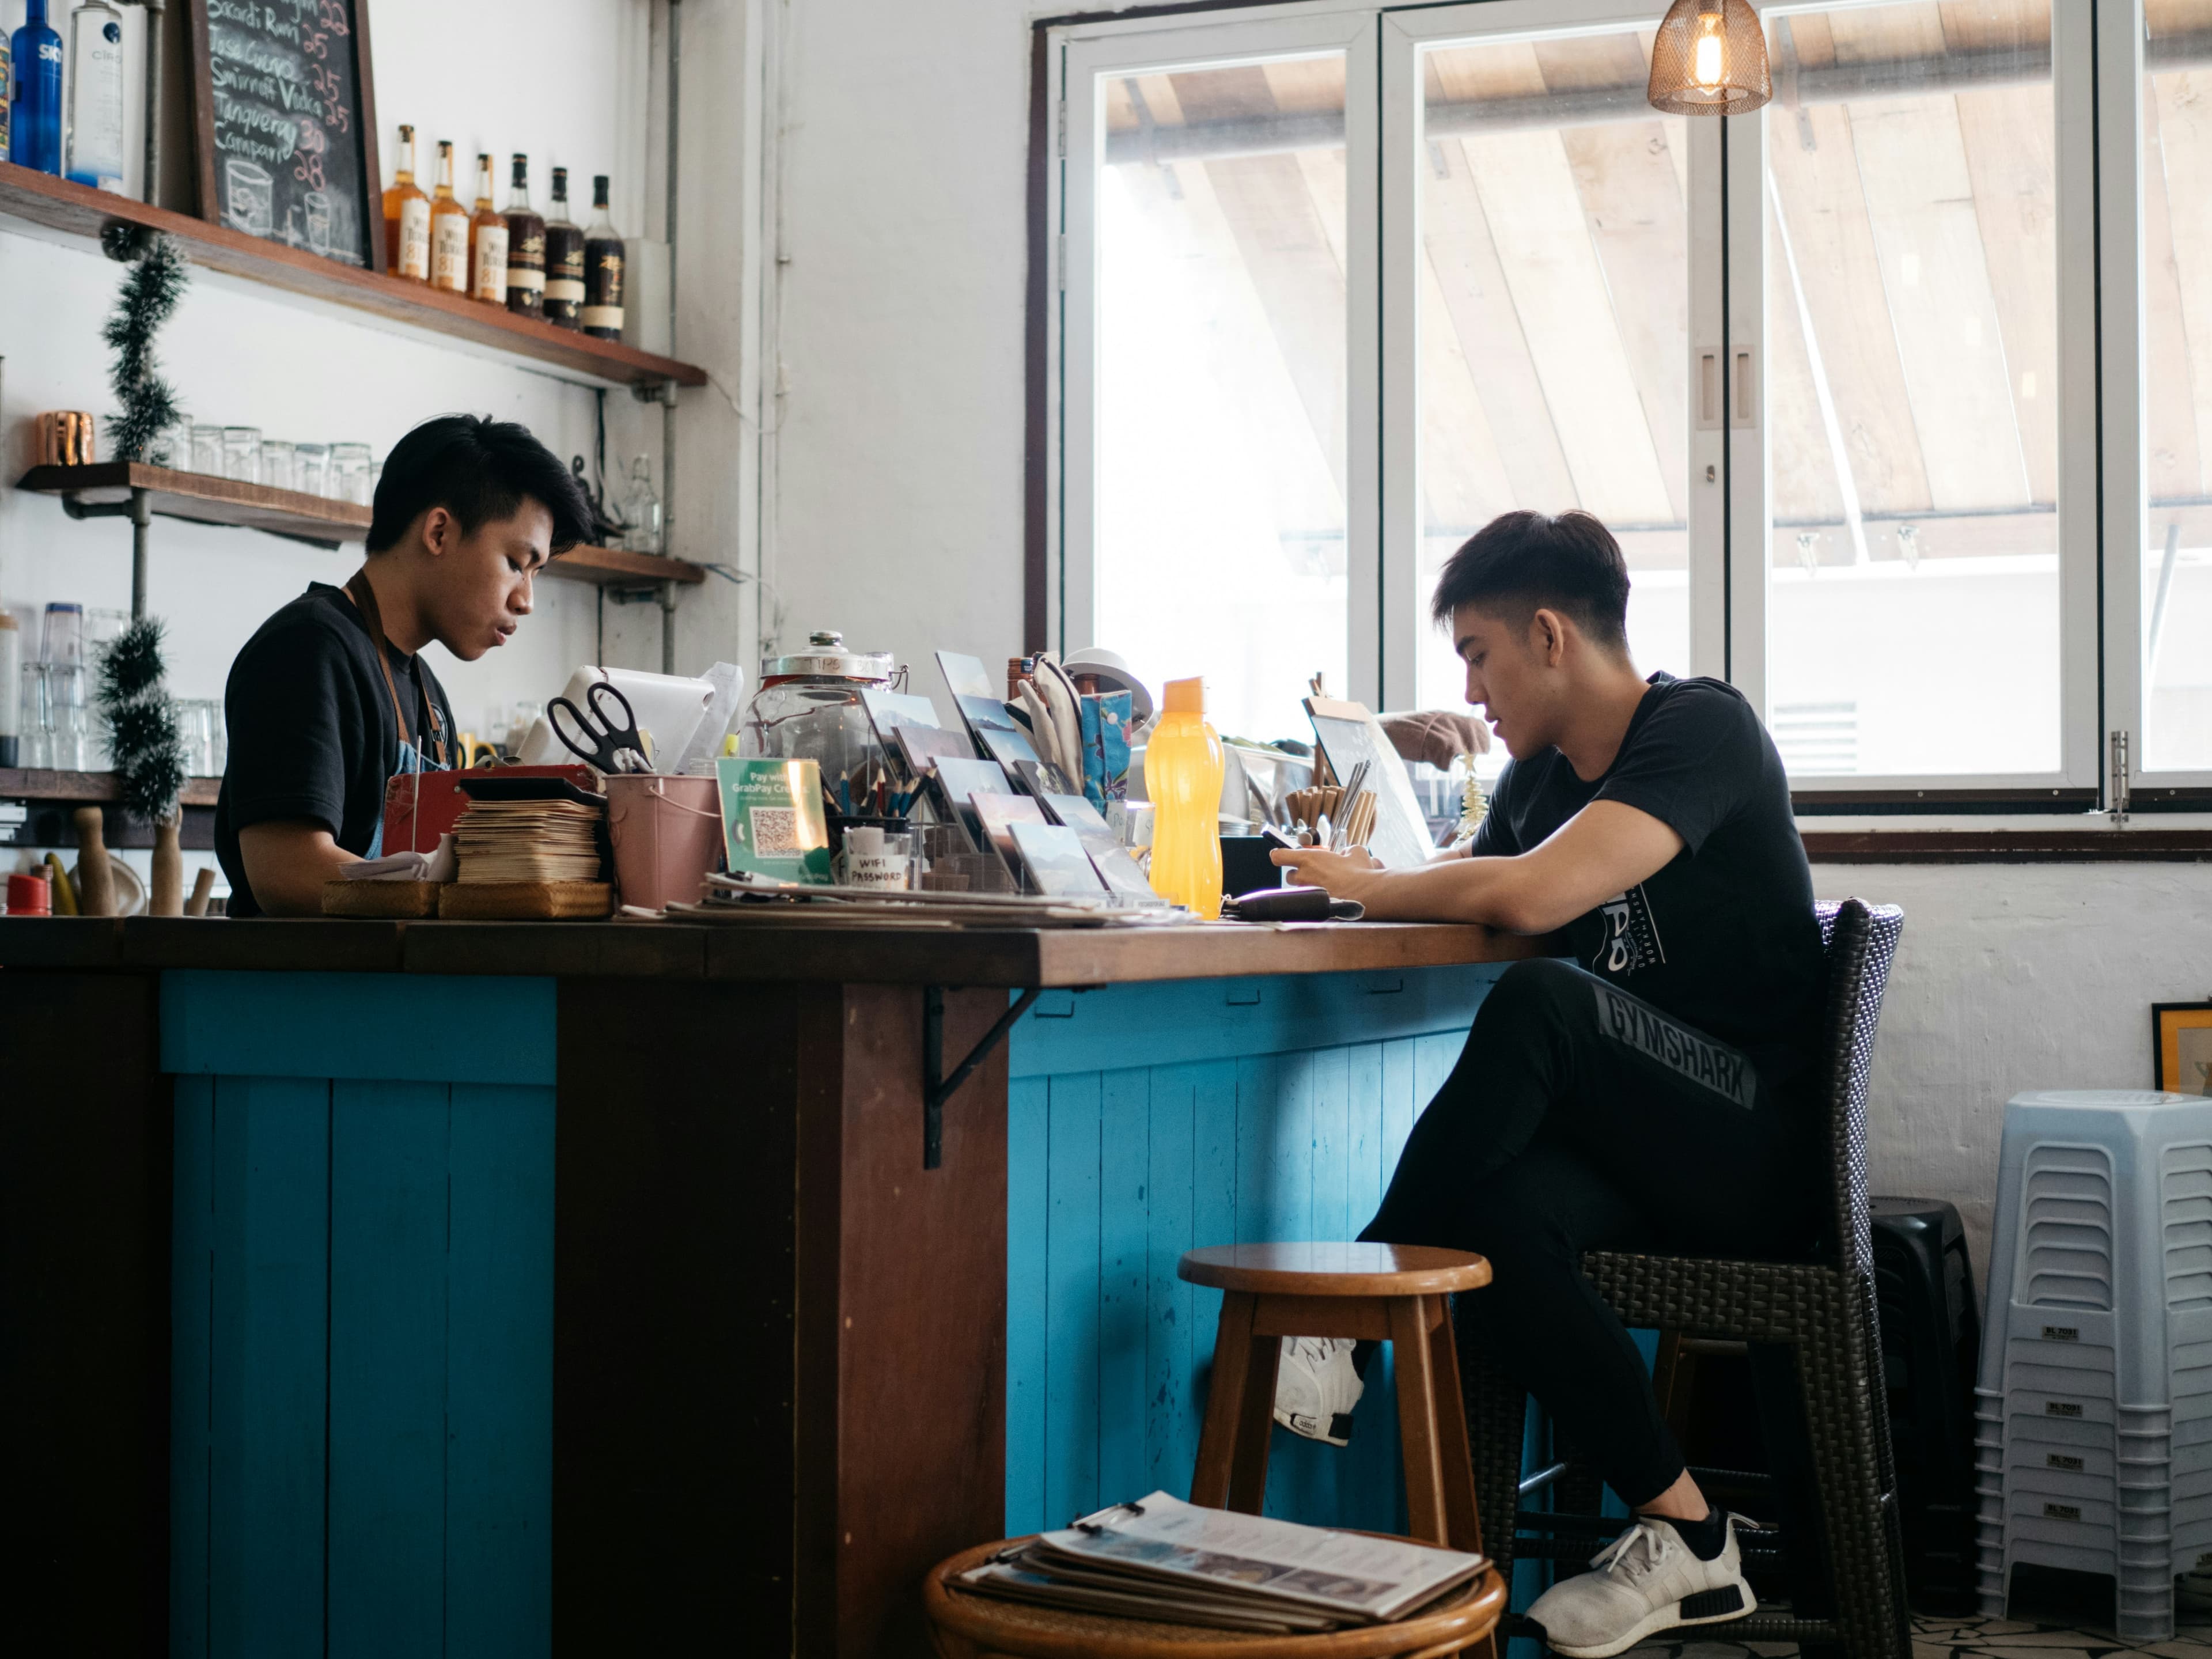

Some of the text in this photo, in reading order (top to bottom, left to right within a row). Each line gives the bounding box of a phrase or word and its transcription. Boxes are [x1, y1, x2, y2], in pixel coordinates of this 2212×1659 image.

[302, 23, 329, 59] 25
[312, 63, 342, 103] 25
[324, 99, 350, 133] 25
[298, 119, 325, 154] 30
[214, 120, 326, 192] Campari 28
[805, 658, 840, 671] TIPS
[732, 783, 772, 795] GrabPay
[750, 772, 768, 783] Pay
[851, 870, 902, 882] PASSWORD
[859, 858, 886, 869] WIFI
[1630, 887, 1657, 964] WORKMANSH
[1605, 991, 1746, 1103] GYMSHARK
